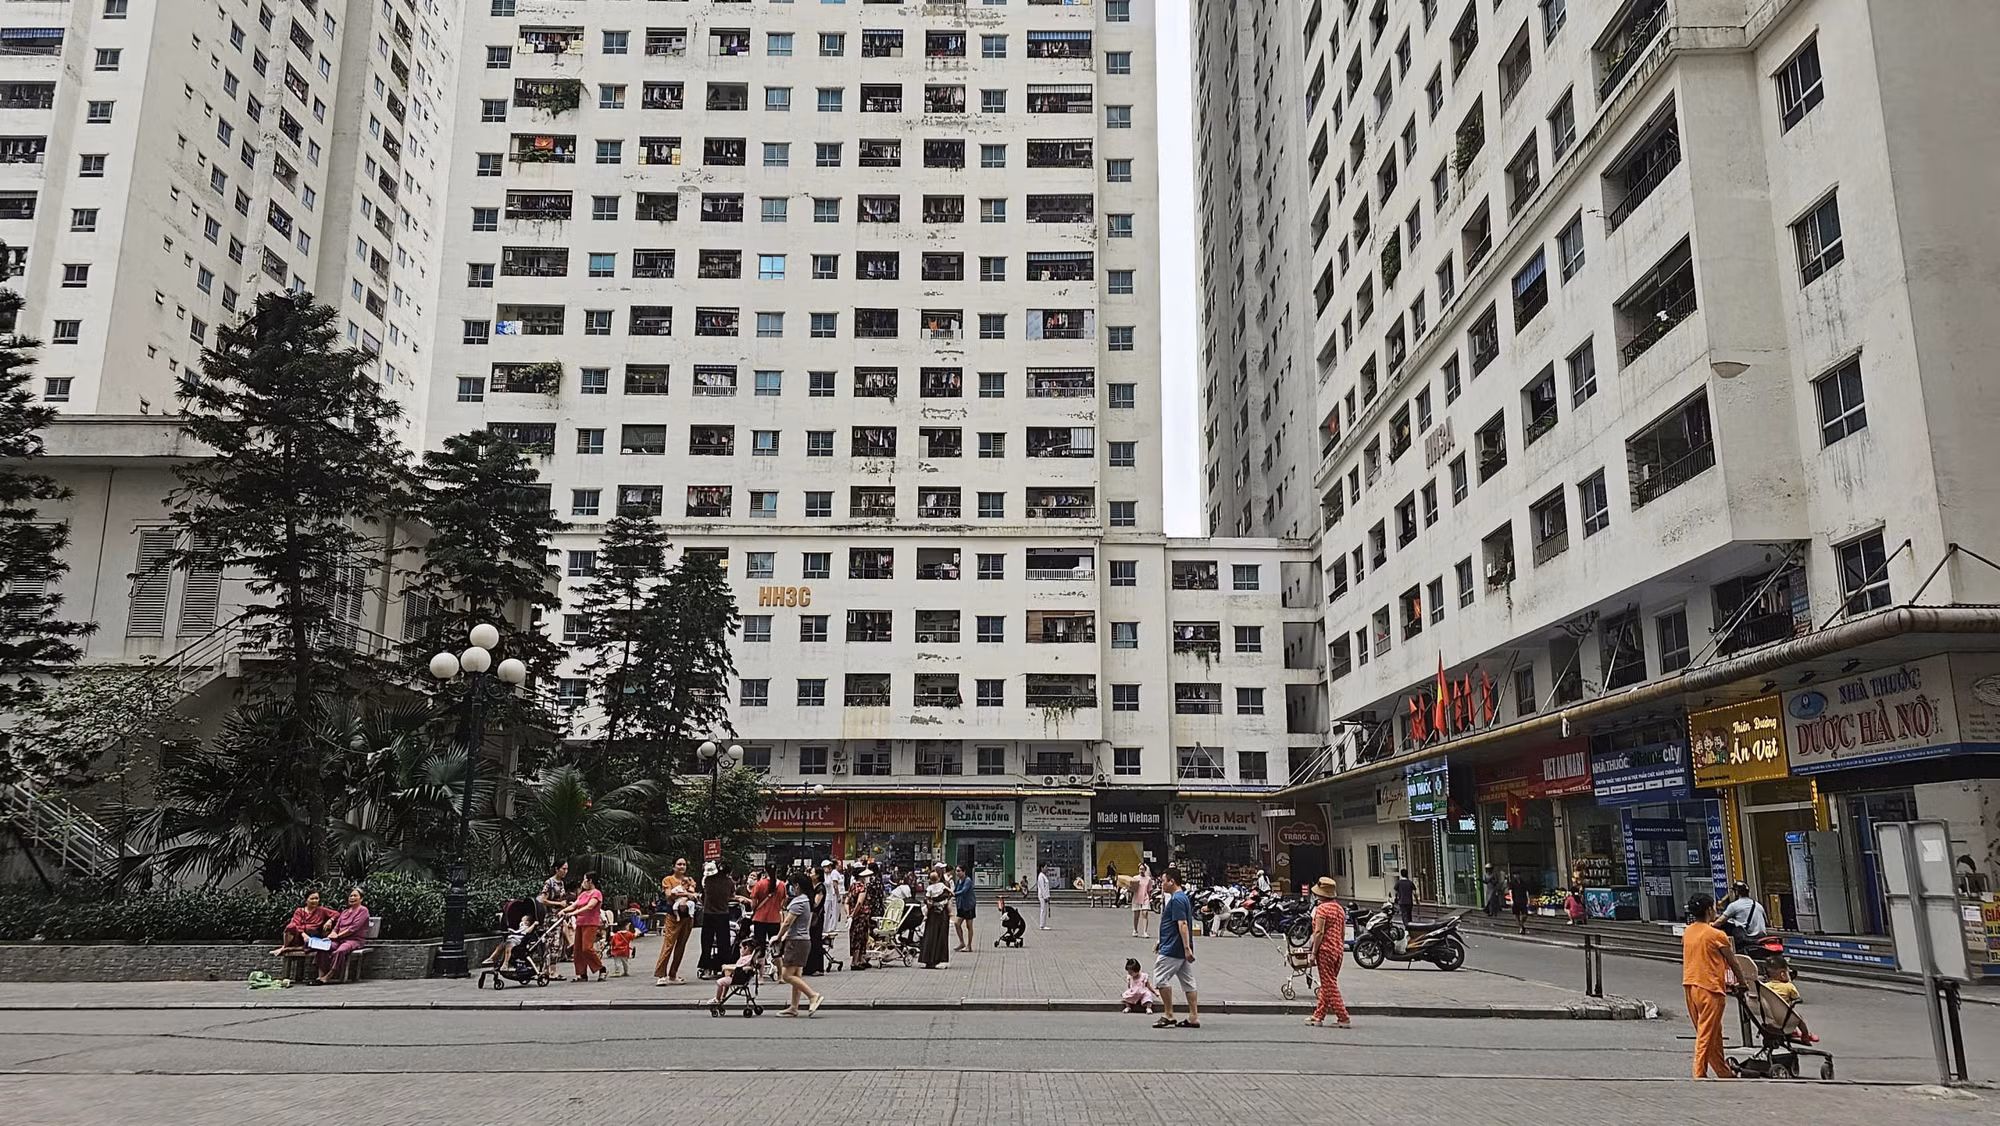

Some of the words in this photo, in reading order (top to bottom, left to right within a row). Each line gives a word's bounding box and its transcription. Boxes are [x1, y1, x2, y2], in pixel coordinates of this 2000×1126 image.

[759, 586, 811, 608] HH3C
[1857, 699, 1895, 747] HÀ
[1730, 737, 1751, 765] Ăn
[1753, 737, 1779, 763] Vặt
[1097, 811, 1118, 823] Made
[1120, 811, 1128, 823] In
[1128, 811, 1160, 823] Vietnam
[1187, 809, 1220, 824] Vina
[1224, 811, 1256, 824] Mart
[1708, 826, 1720, 834] CAM
[1709, 836, 1722, 849] KẾT
